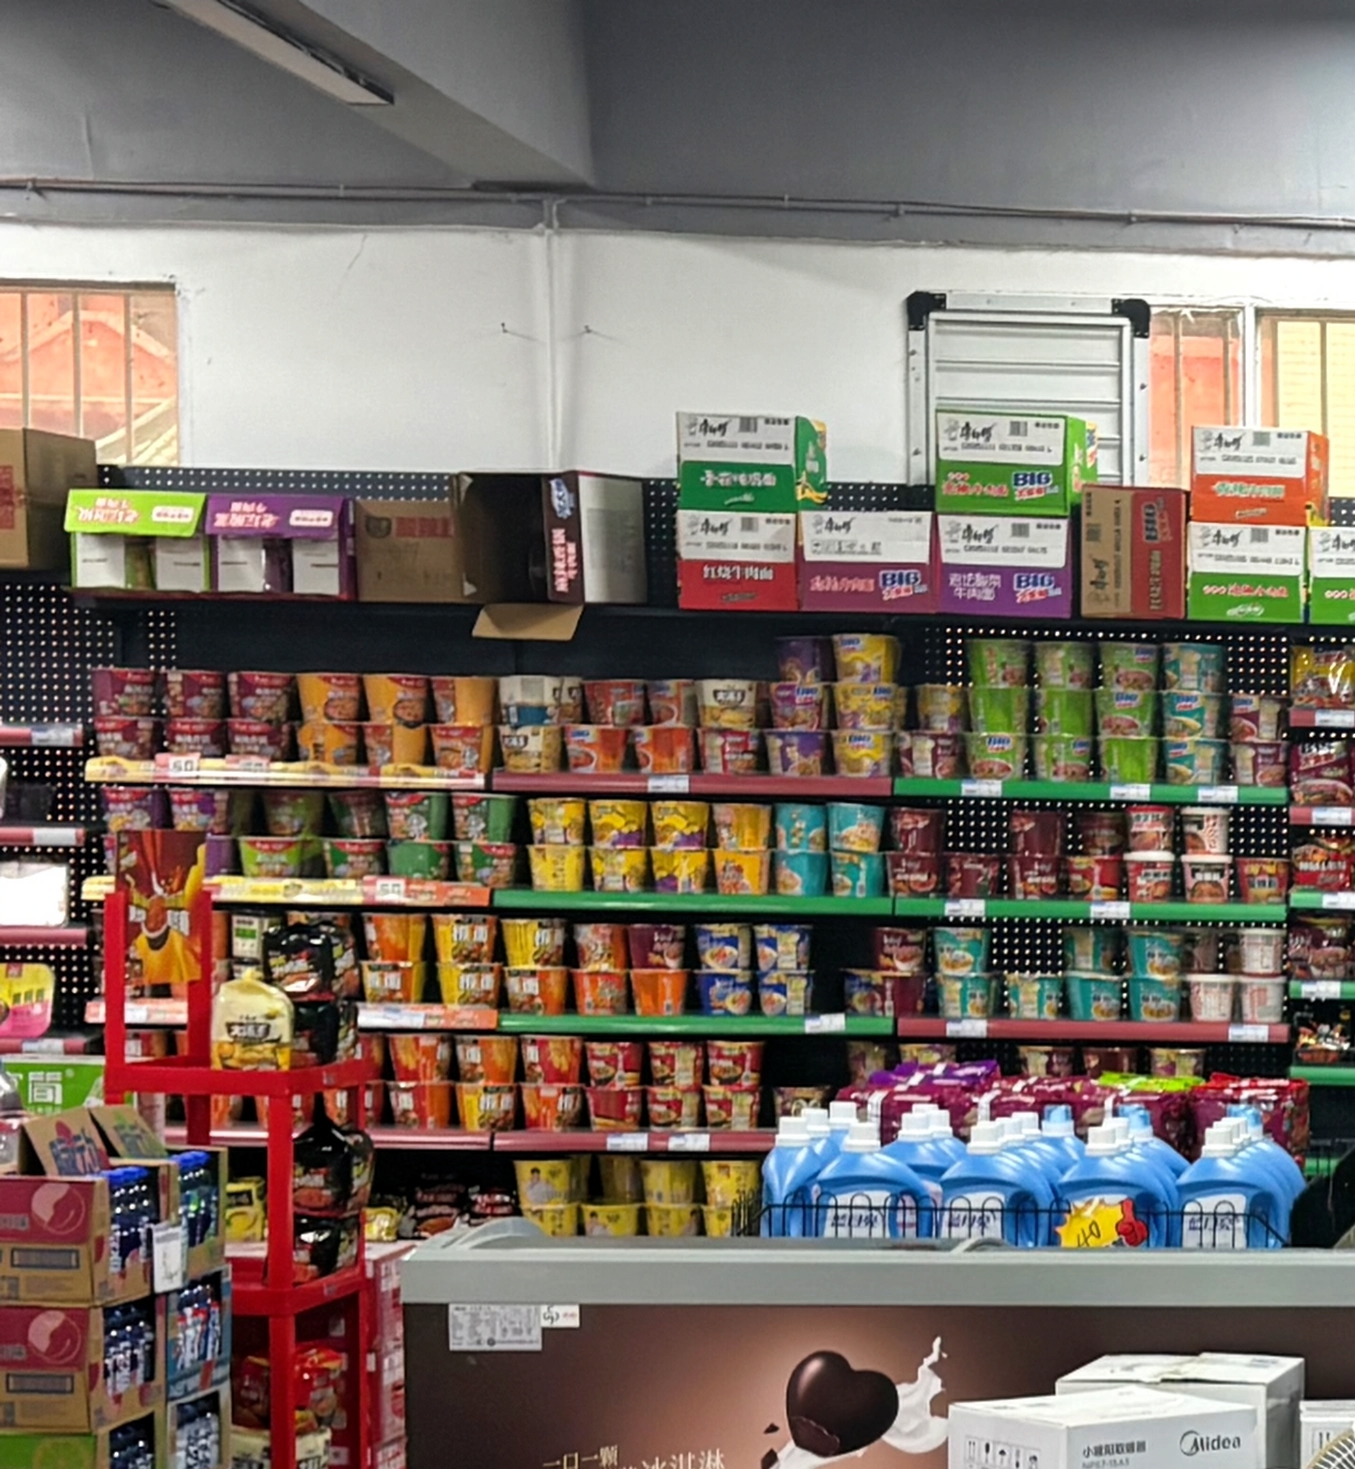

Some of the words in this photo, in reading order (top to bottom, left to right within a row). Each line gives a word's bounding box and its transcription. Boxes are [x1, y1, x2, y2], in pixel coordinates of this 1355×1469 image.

[1012, 471, 1052, 487] BIG
[879, 570, 922, 588] BIG
[1014, 573, 1054, 589] BIG
[1180, 1430, 1242, 1457] Midea
